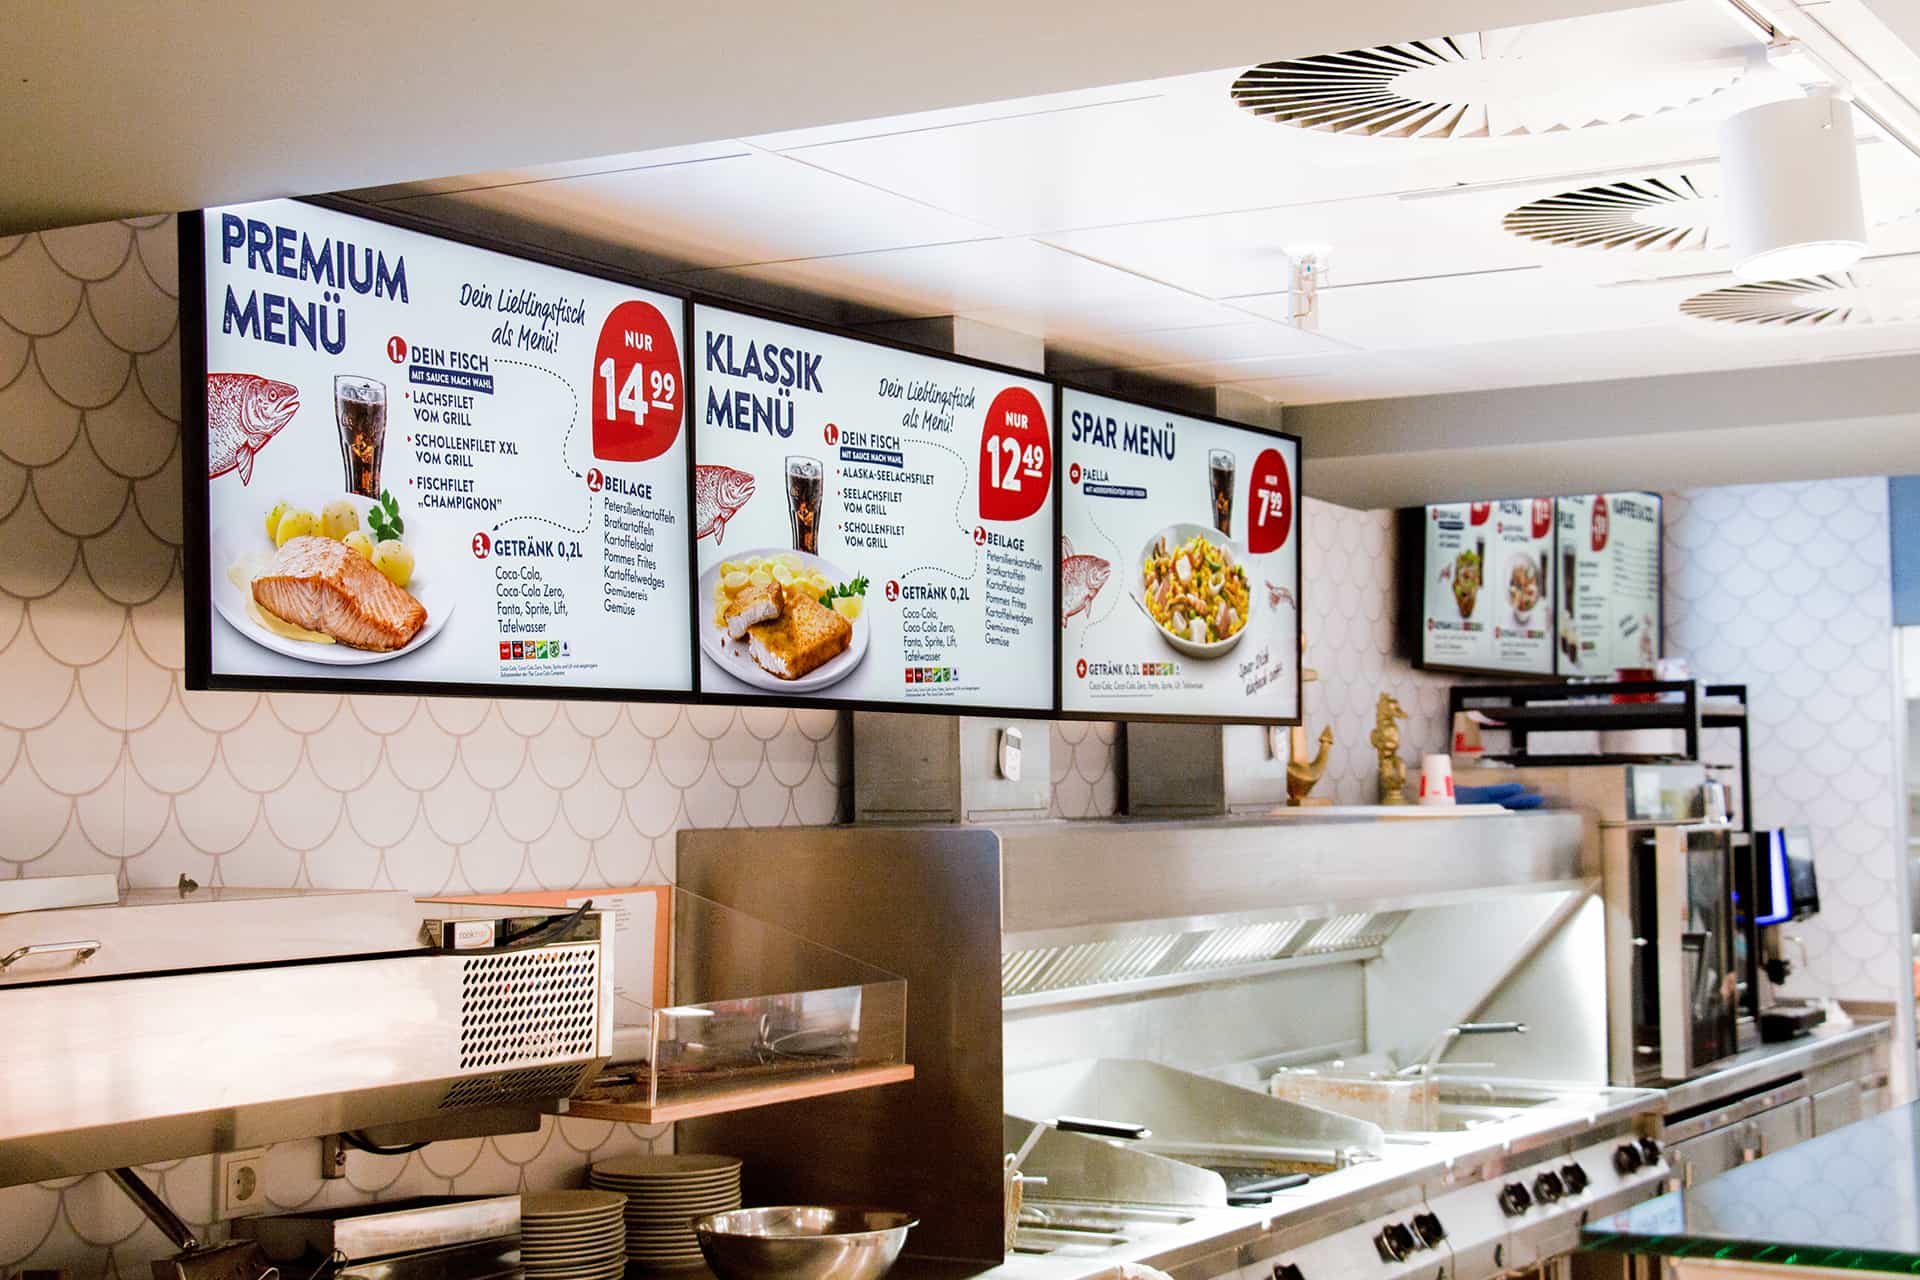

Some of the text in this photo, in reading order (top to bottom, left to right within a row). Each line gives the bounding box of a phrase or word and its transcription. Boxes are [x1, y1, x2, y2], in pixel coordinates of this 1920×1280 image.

[222, 212, 409, 304] PREMIUM
[459, 283, 585, 330] Dein Lieblingsfisch
[222, 284, 346, 355] MENÜ
[491, 321, 559, 354] als Menü!
[624, 329, 653, 352] NUR
[411, 346, 445, 366] DEIN
[450, 352, 489, 372] FISCH
[706, 331, 824, 393] KLASSIK
[411, 370, 492, 389] MIT SAUCE NACH WAHL
[413, 390, 475, 410] LACHSFILET
[878, 378, 976, 415] Dein Lieblingsfisch
[413, 408, 472, 426] VOM GRILL
[706, 385, 794, 439] MENÜ
[902, 408, 955, 433] als Menü!
[1005, 411, 1028, 430] NUR
[415, 434, 518, 456] SCHOLLENFILET XXL
[841, 431, 867, 447] DEIN
[871, 434, 900, 450] FISCH
[1071, 409, 1176, 461] SPAR MENÜ
[415, 451, 473, 468] VOM GRILL
[416, 476, 475, 493] FISCHFILET
[843, 468, 935, 485] ALASKA-SEELACHSFILET
[1082, 468, 1109, 481] PAELLA
[605, 476, 653, 500] BEILAGE
[843, 488, 903, 503] SEELACHSFILET
[604, 497, 676, 524] Petersilienkartoffeln
[843, 503, 887, 516] VOM GRILL
[604, 515, 654, 537] Bratkartoffeln
[844, 522, 905, 536] SCHOLLENFILET
[494, 536, 554, 558] GETRÄNK
[558, 541, 583, 562] 0,2L
[604, 532, 654, 553] Kartoffelsalat
[845, 536, 888, 549] VOM GRILL
[988, 532, 1025, 551] BEILAGE
[604, 548, 657, 570] Pommes Frites
[495, 565, 543, 581] Coca-Cola,
[604, 567, 665, 591] Kartoffelwedges
[496, 583, 565, 600] Coca-Cola Zero,
[604, 583, 648, 601] Gemüsereis
[902, 583, 947, 601] GETRÄNK
[950, 587, 970, 604] 0,2L
[497, 600, 569, 618] Fanta, Sprite, Lift,
[604, 599, 636, 616] Gemüse
[498, 619, 547, 634] Tafelwasser
[1088, 659, 1122, 676] GETRÄNK
